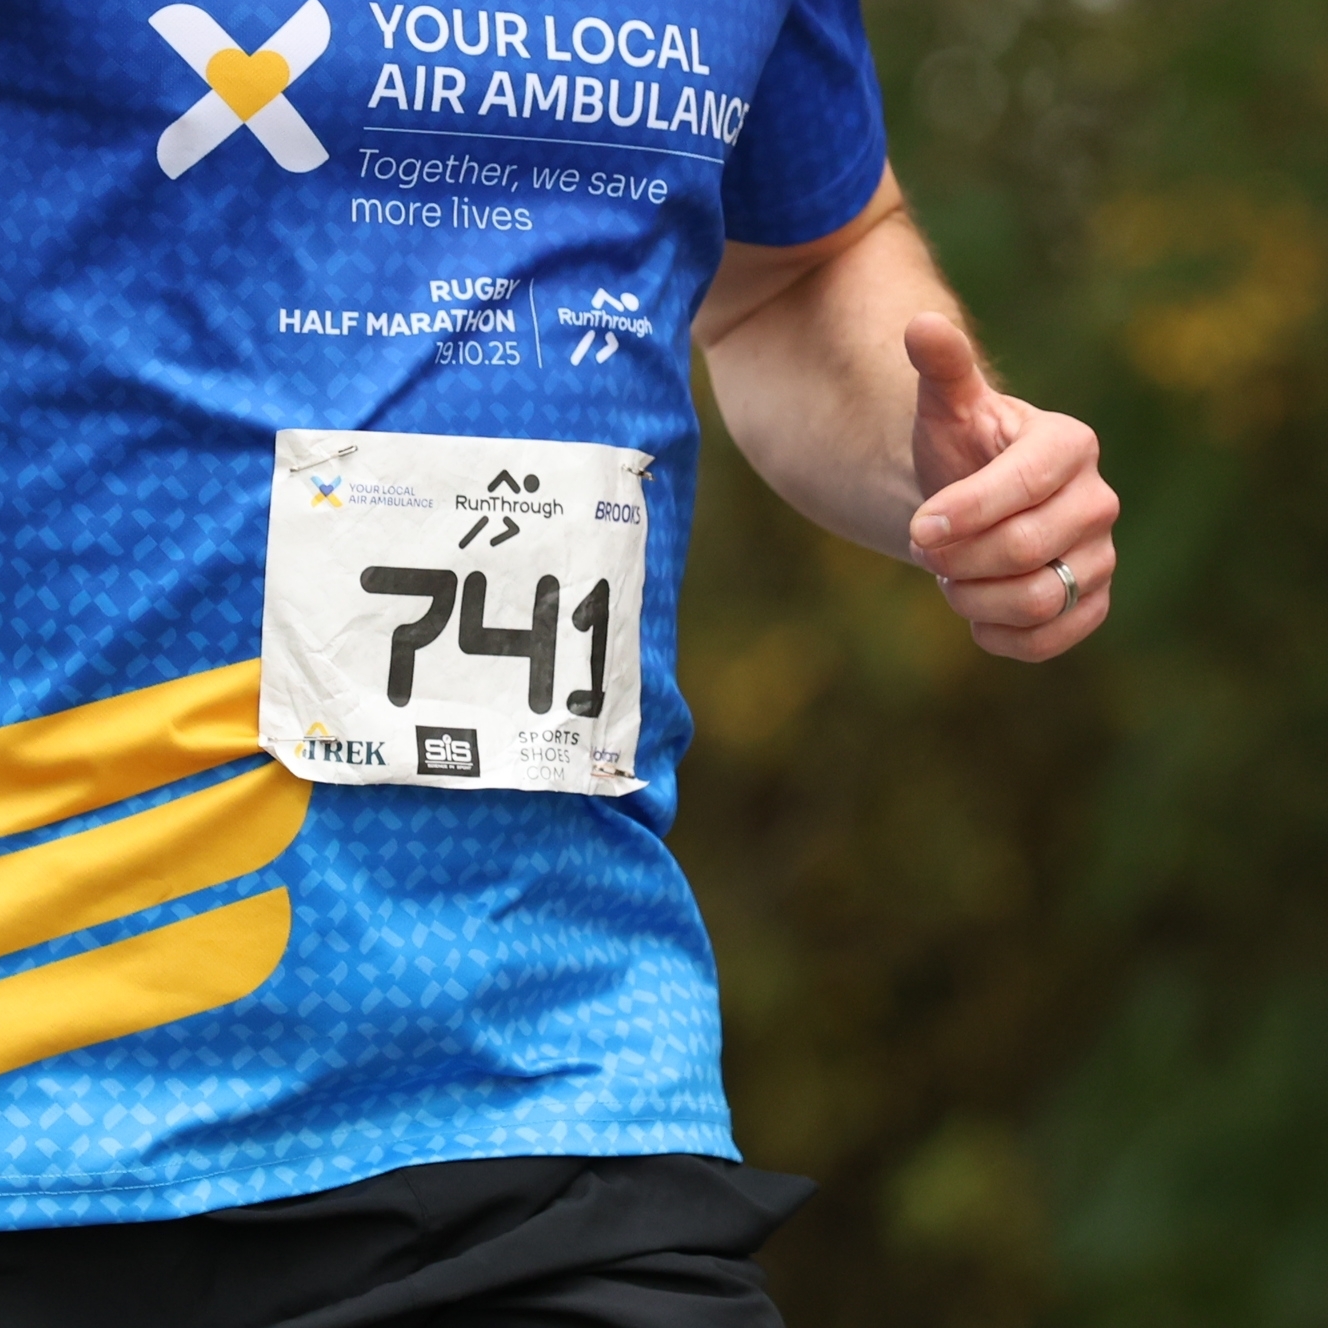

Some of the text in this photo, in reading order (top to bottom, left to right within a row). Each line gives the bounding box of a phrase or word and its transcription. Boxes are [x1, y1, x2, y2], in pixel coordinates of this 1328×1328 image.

[368, 1, 711, 76] YOUR LOCAL
[366, 62, 467, 115] AIR
[358, 148, 669, 205] Together, we save
[350, 195, 534, 231] more lives
[428, 276, 521, 304] RUGBY
[278, 307, 517, 337] HALF MARATHON
[557, 307, 654, 339] RunThrough
[434, 340, 522, 366] 19.10.25
[348, 495, 434, 509] AIR AMBULANCE
[349, 483, 416, 497] YOUR LOCAL
[455, 494, 565, 520] RunThrough
[359, 565, 610, 719] 741
[518, 729, 581, 746] SPORTS
[520, 747, 571, 764] SHOES
